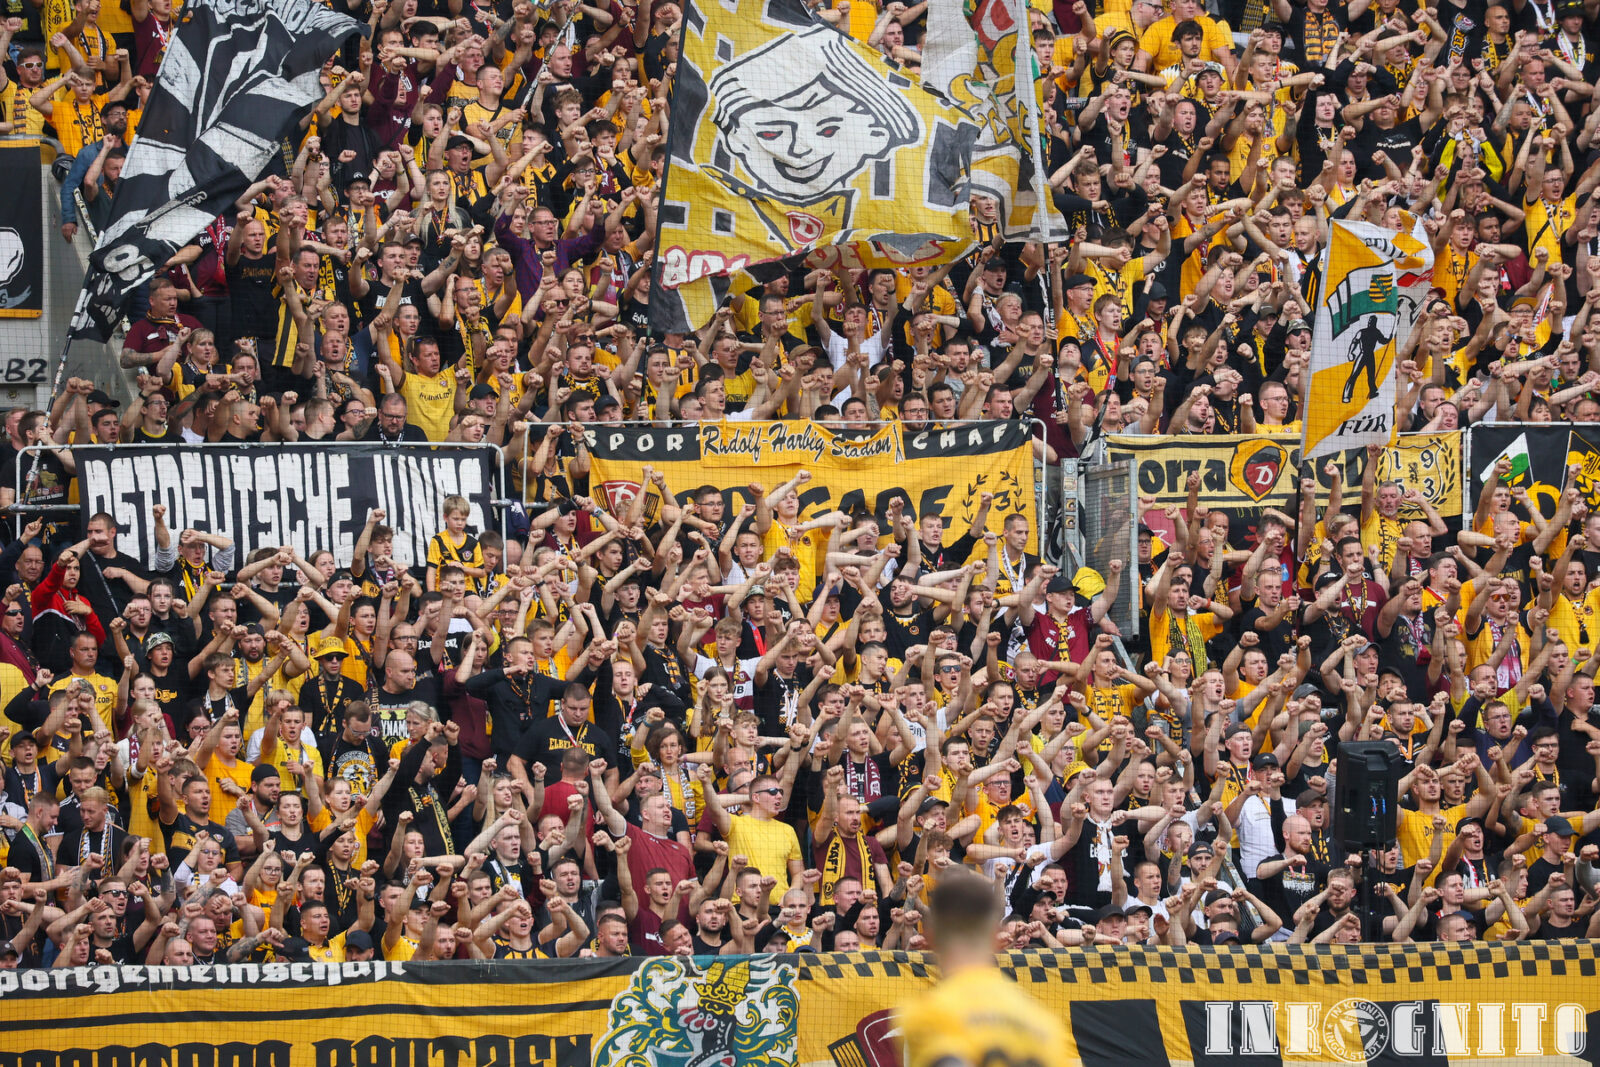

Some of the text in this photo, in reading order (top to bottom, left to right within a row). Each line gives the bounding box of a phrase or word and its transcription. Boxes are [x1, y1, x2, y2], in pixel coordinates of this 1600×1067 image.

[1335, 413, 1388, 437] FÜR
[583, 428, 700, 453] SPOR
[84, 451, 353, 572] OSTDEUTSCHE
[548, 737, 596, 756] ELBFLENZ
